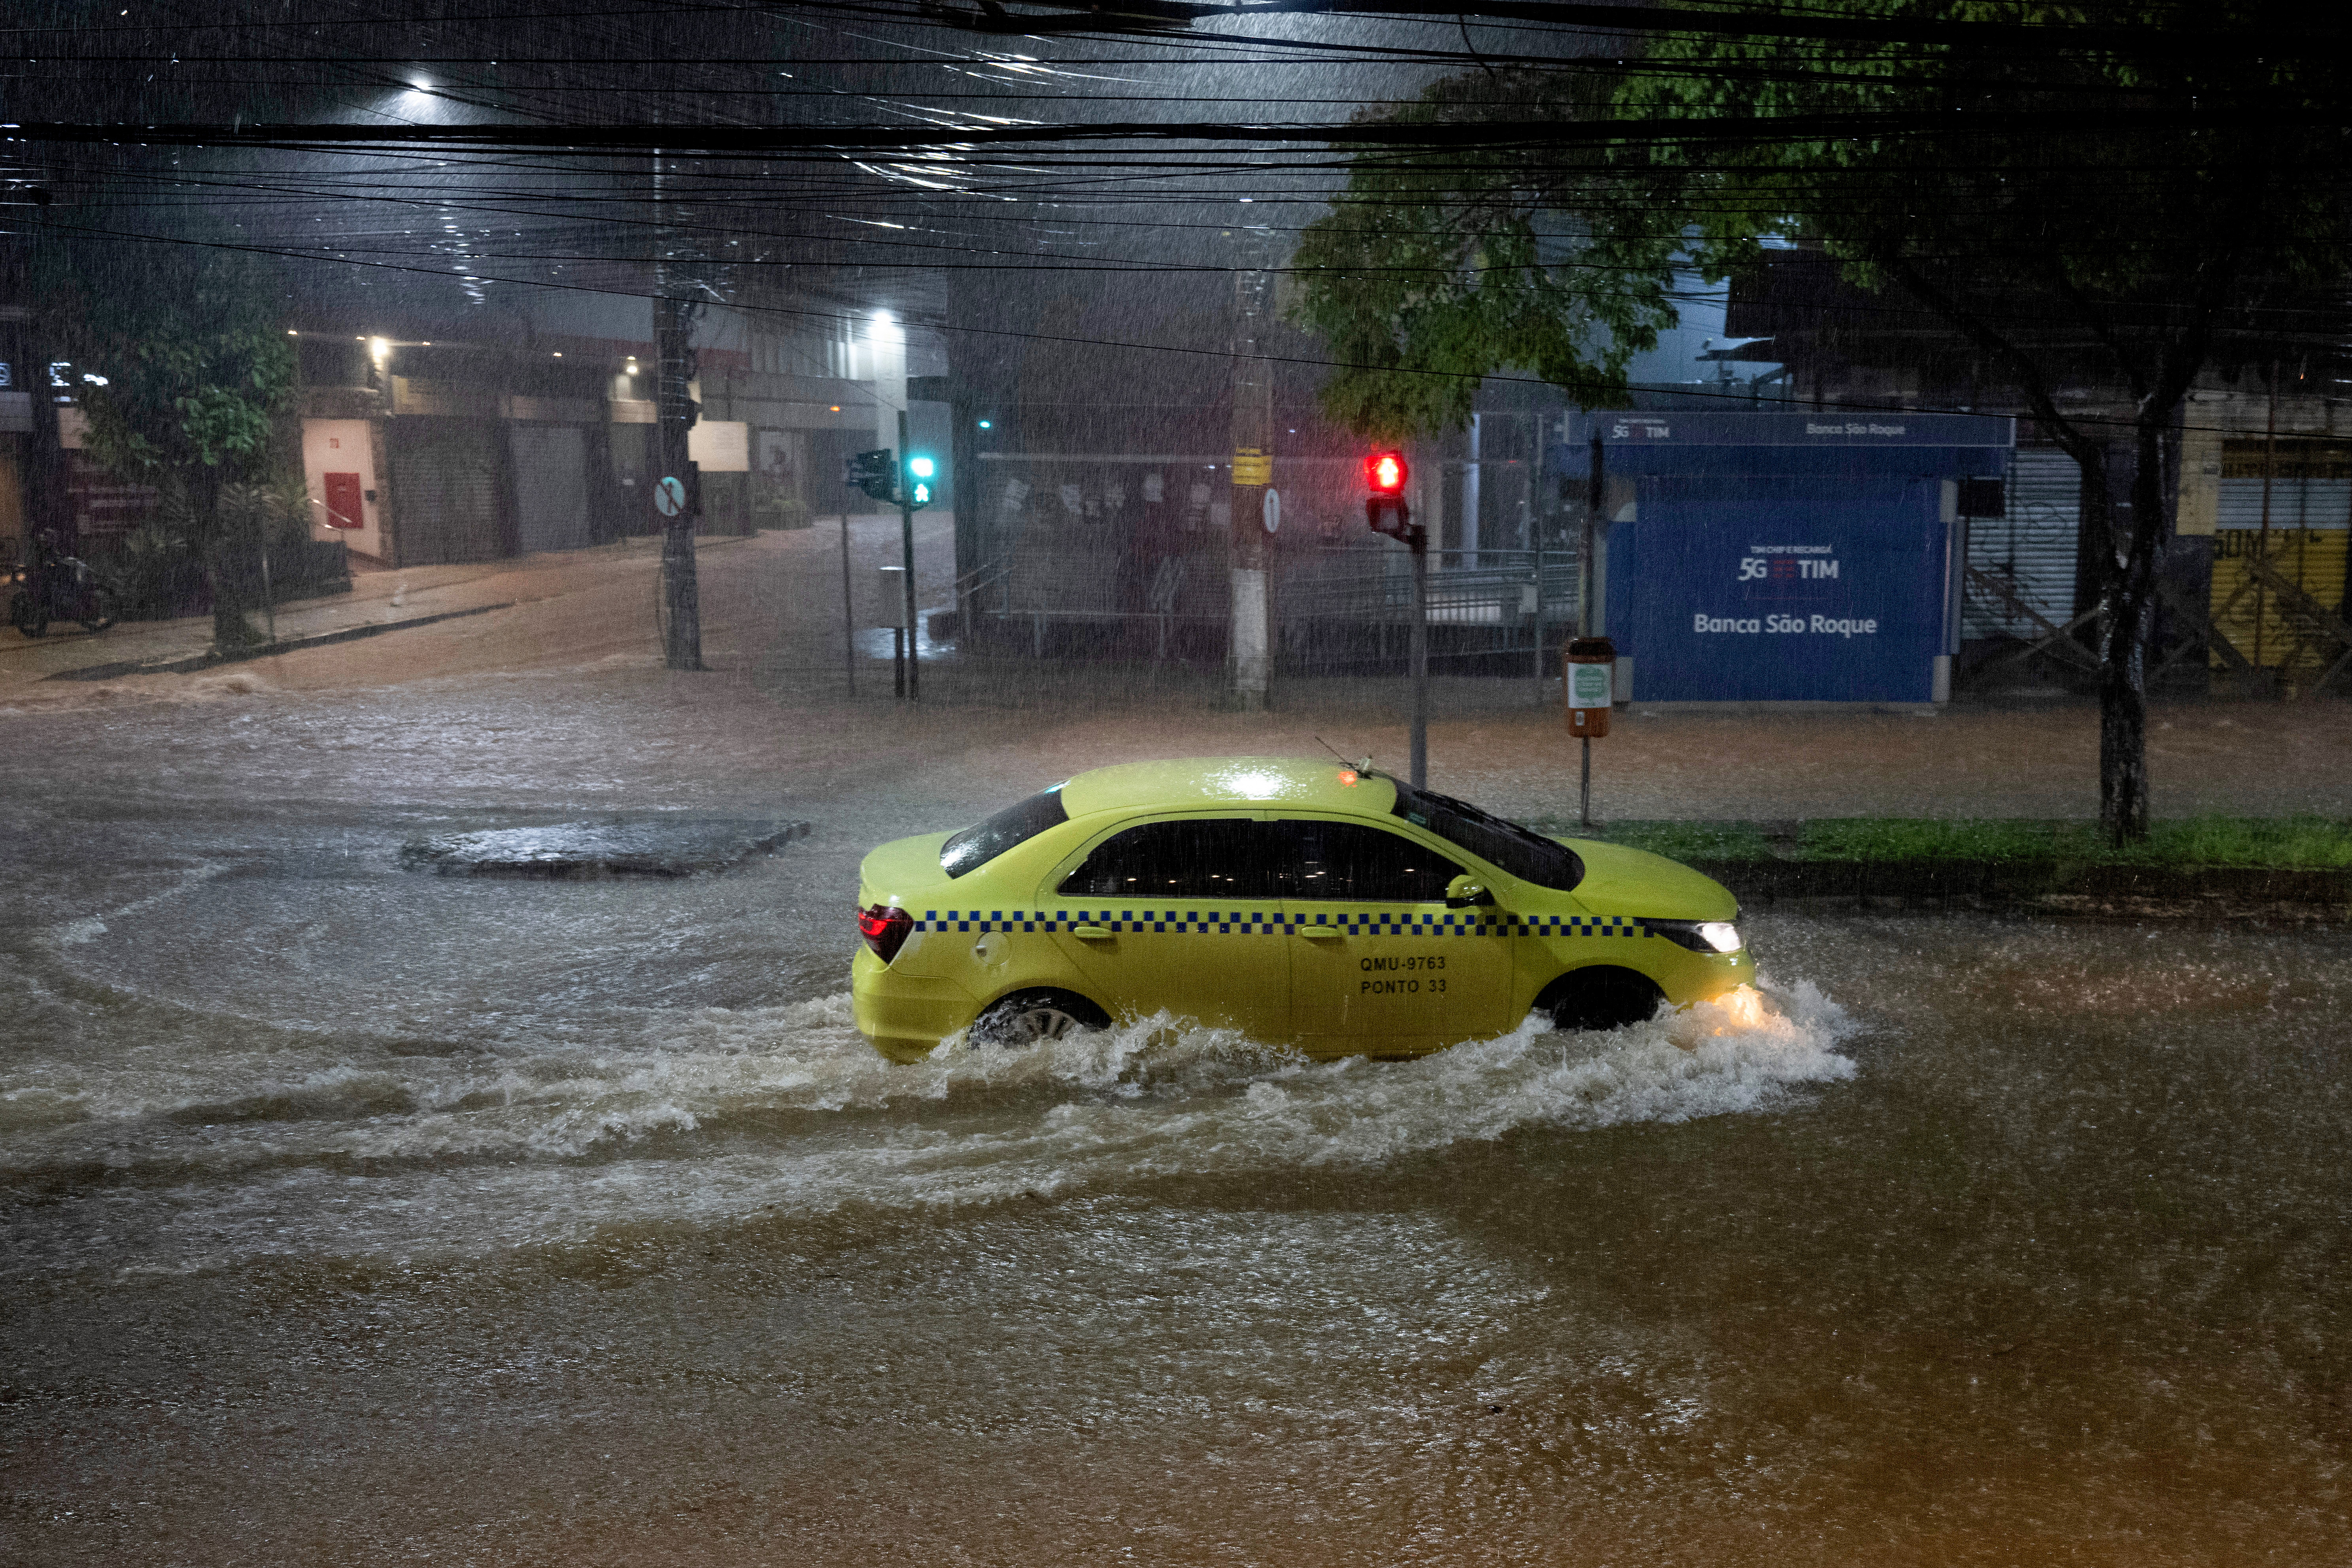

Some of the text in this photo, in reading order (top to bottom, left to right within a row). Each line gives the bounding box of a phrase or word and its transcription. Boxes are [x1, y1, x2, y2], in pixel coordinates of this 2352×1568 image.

[1612, 425, 1669, 438] 5G TIM
[1806, 423, 1905, 437] Banca São Roque
[1738, 558, 1839, 581] 5G TIM
[1694, 613, 1877, 638] Banca São Roque
[1360, 956, 1446, 971] QMU-9763
[1361, 979, 1447, 994] PONTO 33
